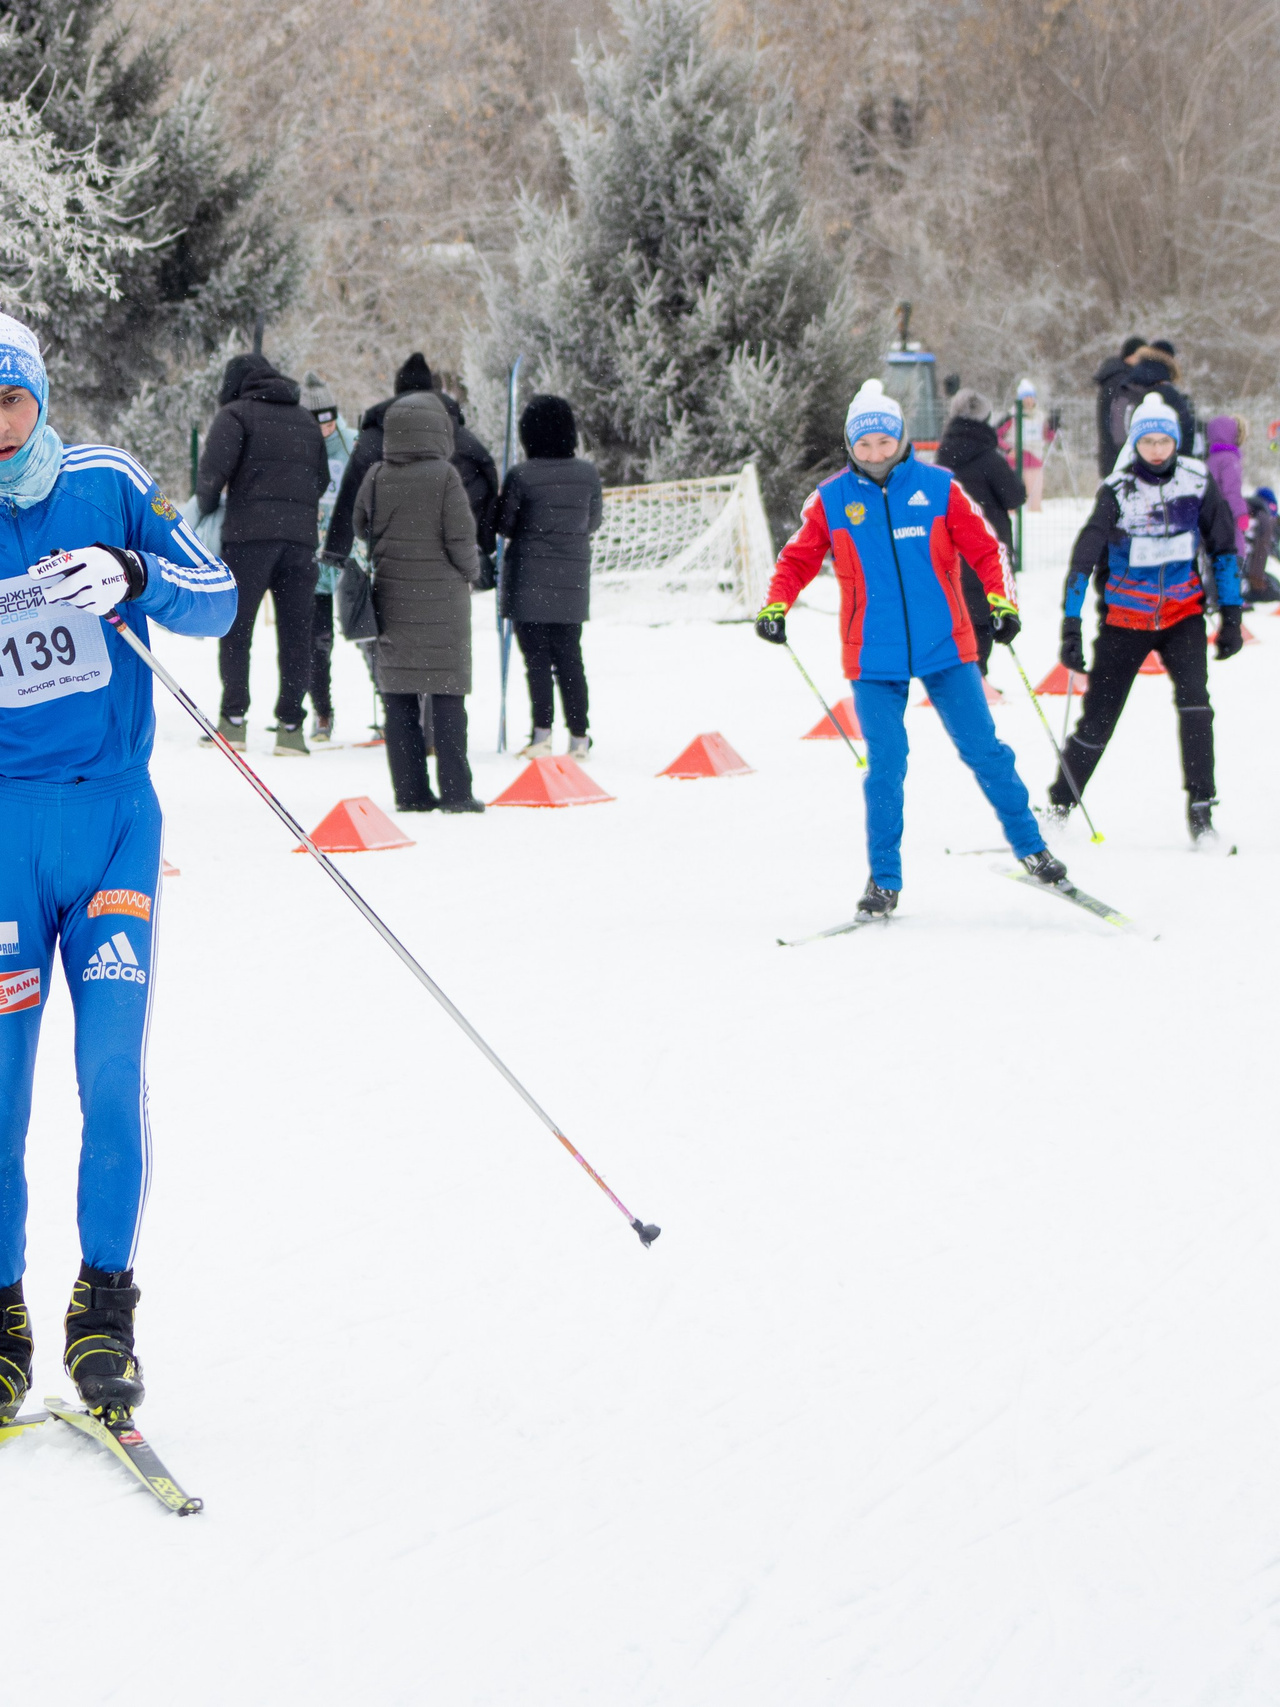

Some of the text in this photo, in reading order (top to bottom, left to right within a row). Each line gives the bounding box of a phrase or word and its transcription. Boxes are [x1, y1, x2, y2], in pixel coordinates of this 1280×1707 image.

[892, 525, 926, 540] LUKOIL
[0, 608, 39, 625] 2025
[17, 680, 56, 696] ОМСКАЯ
[105, 890, 151, 912] СОГЛАСИЕ
[82, 961, 146, 984] adidas
